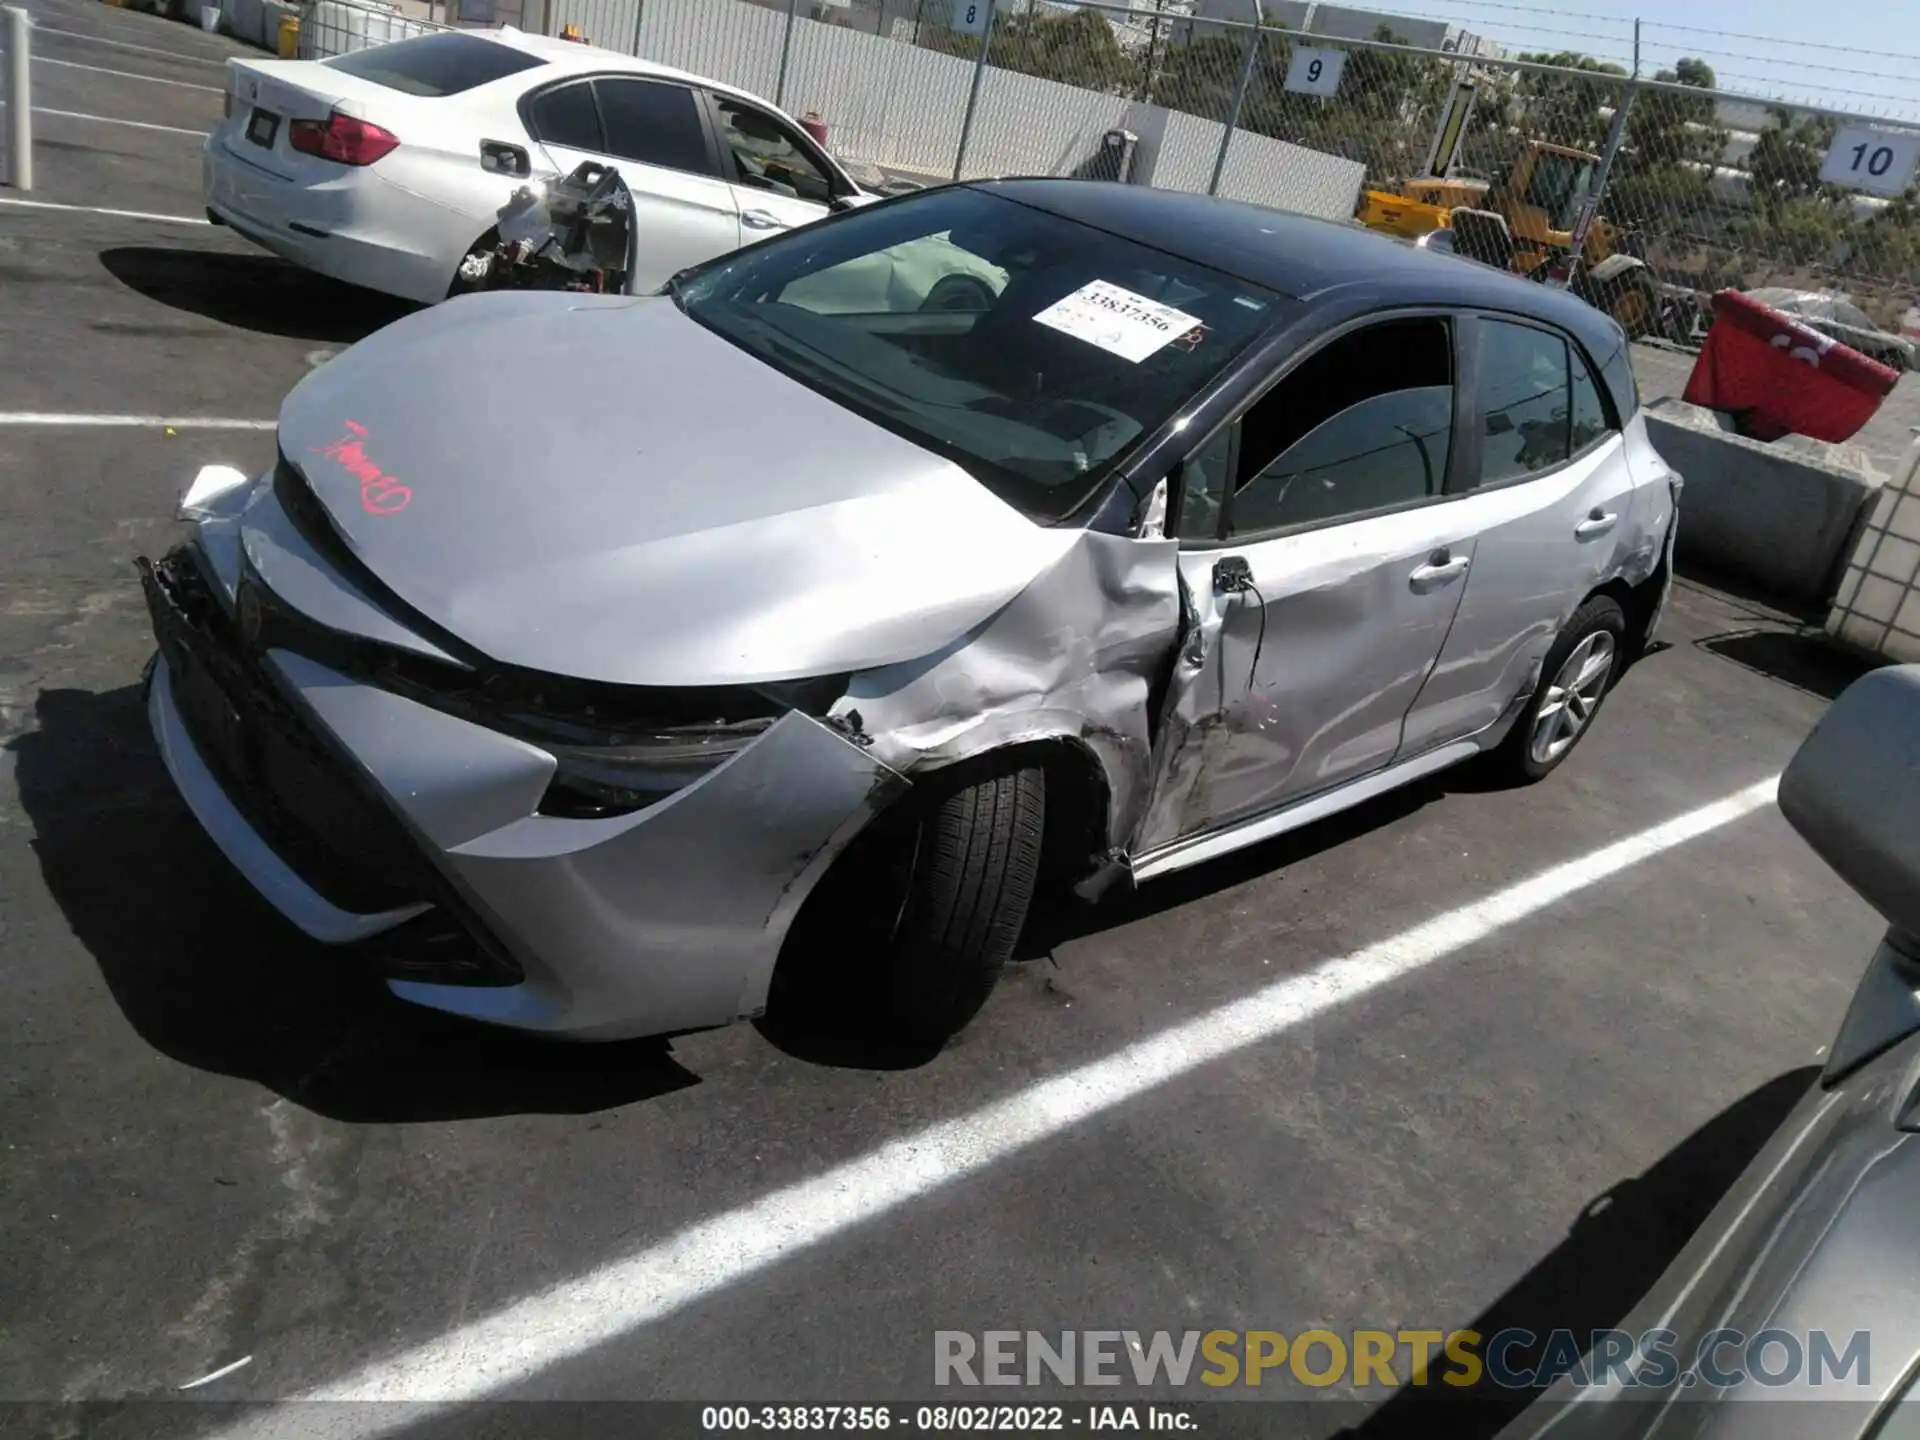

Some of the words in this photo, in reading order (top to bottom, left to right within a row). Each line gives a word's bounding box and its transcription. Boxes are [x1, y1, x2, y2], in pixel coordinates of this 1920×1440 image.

[966, 5, 976, 24] 8
[1307, 59, 1323, 82] 9
[1851, 143, 1894, 176] 10
